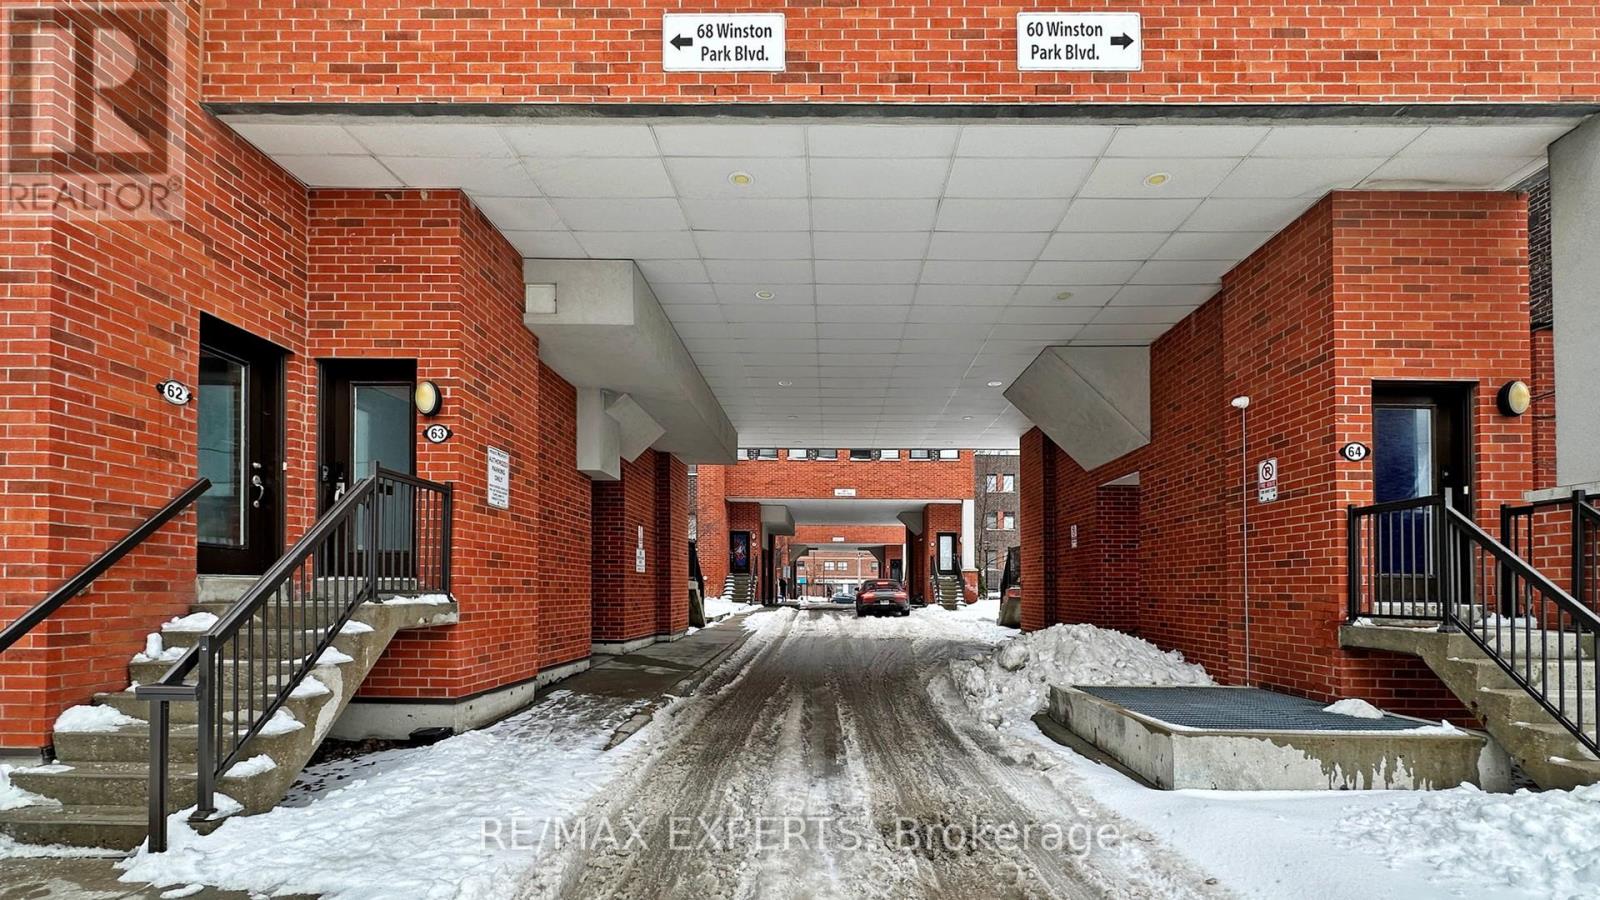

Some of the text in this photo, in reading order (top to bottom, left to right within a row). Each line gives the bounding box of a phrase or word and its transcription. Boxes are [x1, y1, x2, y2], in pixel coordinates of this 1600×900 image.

[697, 23, 772, 38] 68 Winston
[1027, 21, 1103, 37] 60 Winston
[701, 45, 769, 61] Park Blvd.
[1031, 44, 1100, 60] Park Blvd.
[167, 384, 183, 401] 62
[431, 428, 444, 439] 63
[1348, 446, 1362, 457] 64
